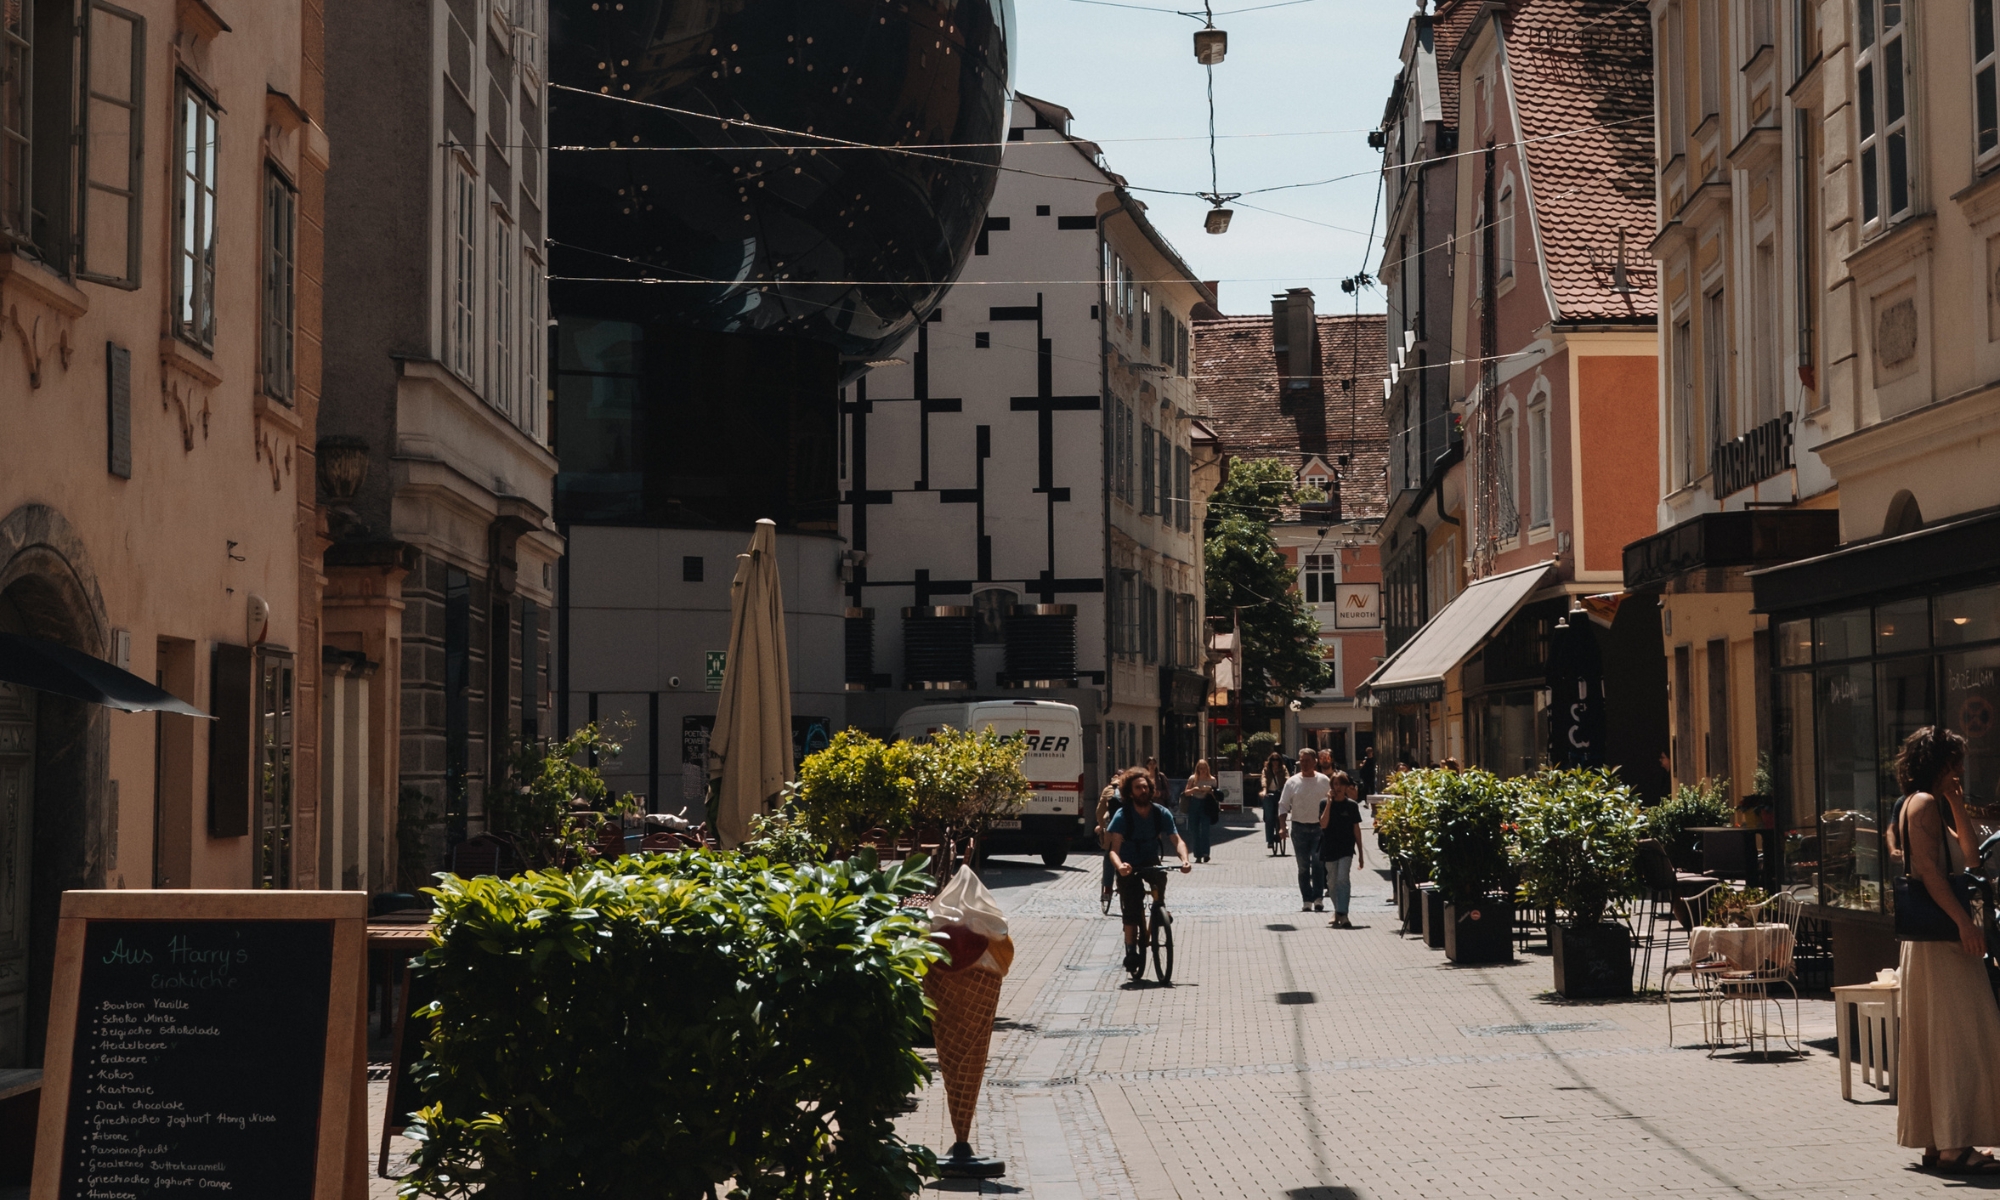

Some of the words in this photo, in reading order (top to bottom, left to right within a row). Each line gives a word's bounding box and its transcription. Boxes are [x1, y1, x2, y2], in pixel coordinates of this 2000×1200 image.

[102, 937, 153, 965] Aus
[102, 1001, 145, 1010] Bourbon
[153, 998, 189, 1010] Vanille
[102, 1014, 137, 1024] Schoko
[159, 1026, 220, 1036] Schokolade
[99, 1041, 168, 1050] Heidelbeere
[100, 1054, 148, 1064] Erdbeere
[97, 1069, 134, 1080] Kokos
[96, 1084, 154, 1095] Kastanie
[96, 1101, 125, 1110] Dark
[167, 1112, 212, 1128] Joghurt
[90, 1144, 168, 1157] Passionsfrucht
[150, 1160, 226, 1171] Butterkaramell
[154, 1176, 195, 1189] Joghurt
[198, 1177, 233, 1190] Orange
[86, 1191, 137, 1200] Himbeere
